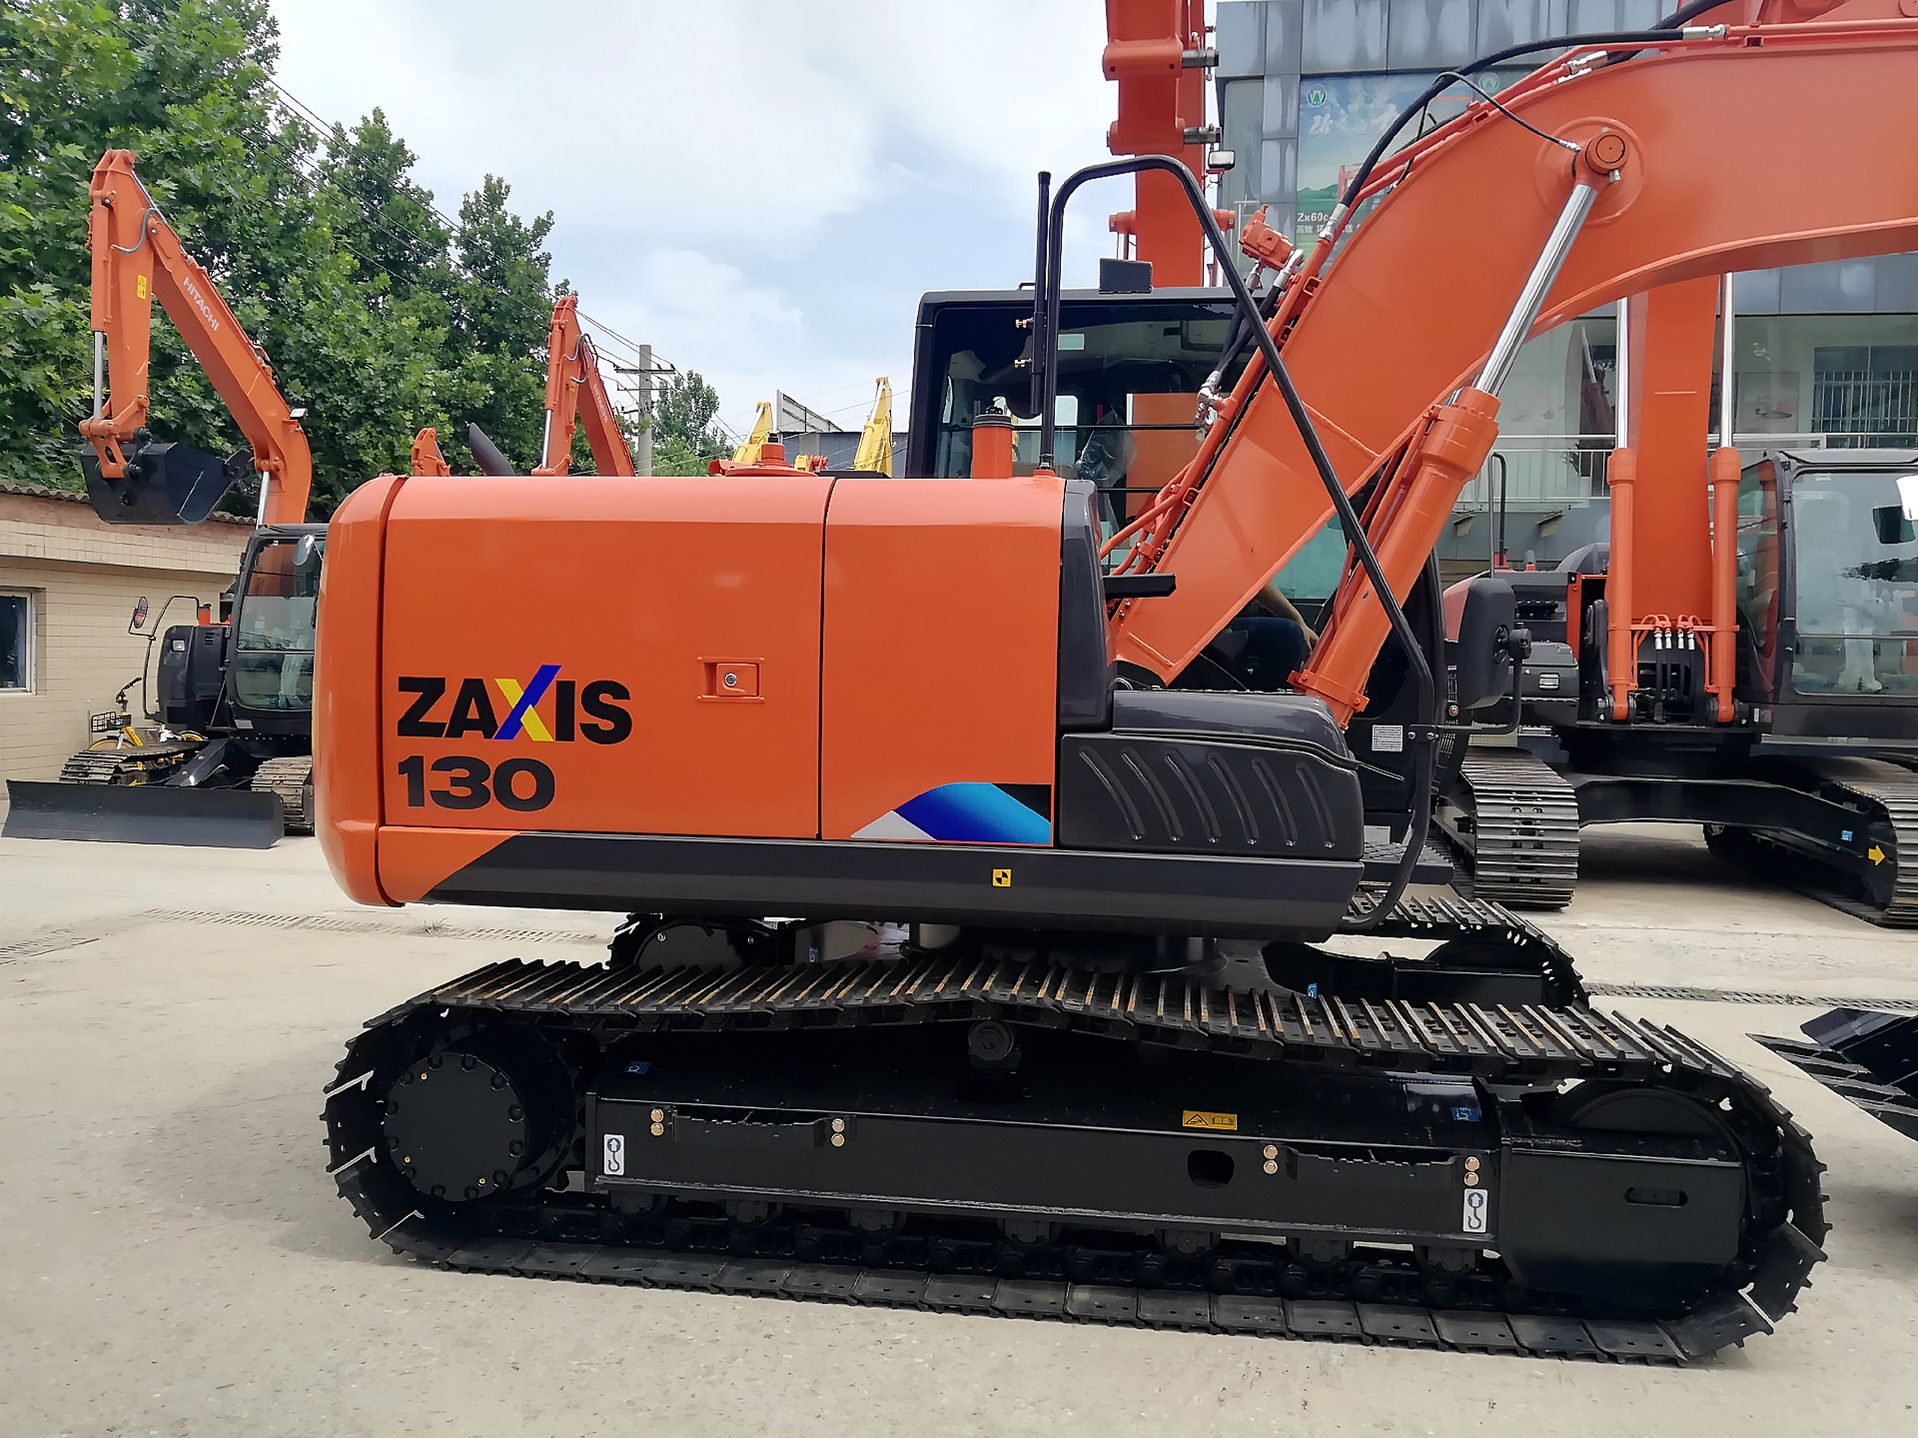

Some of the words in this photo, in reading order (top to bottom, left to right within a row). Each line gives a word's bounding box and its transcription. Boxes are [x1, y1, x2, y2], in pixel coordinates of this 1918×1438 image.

[182, 276, 219, 331] HITACHI
[397, 664, 633, 744] ZAXIS
[397, 755, 555, 811] 130
